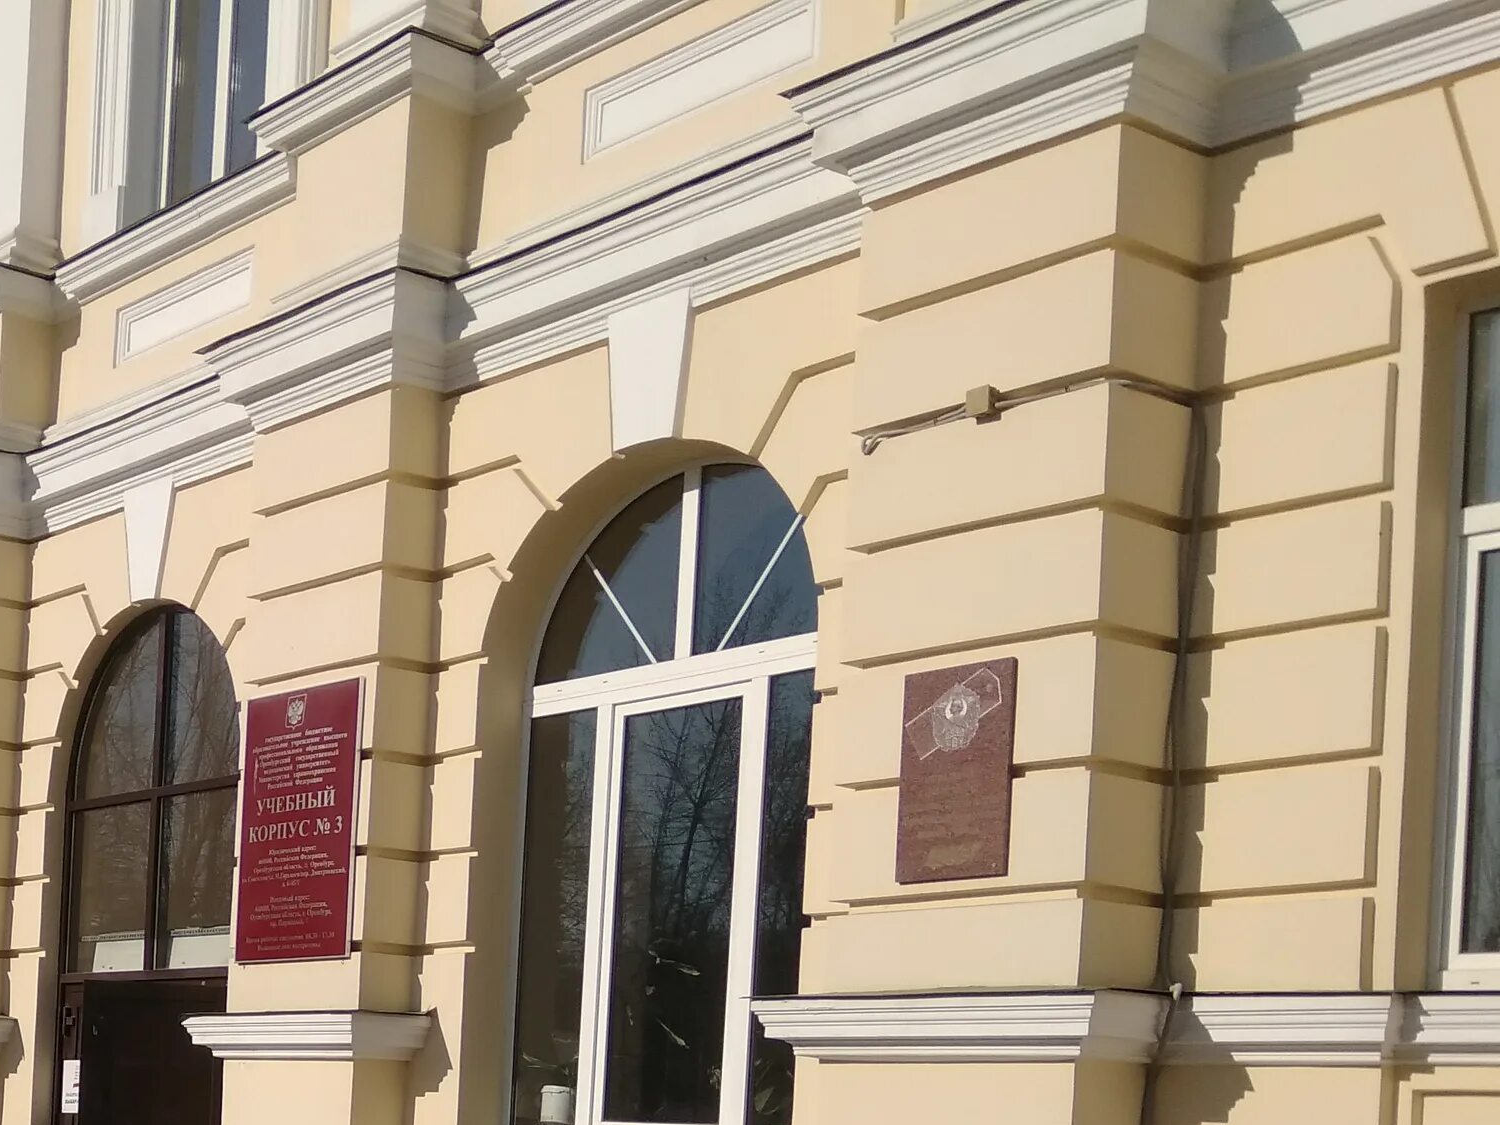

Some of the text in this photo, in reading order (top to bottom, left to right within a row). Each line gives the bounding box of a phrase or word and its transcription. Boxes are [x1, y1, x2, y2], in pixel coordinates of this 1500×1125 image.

[257, 785, 336, 816] УЧЕБНЫЙ
[249, 819, 311, 843] КОРПУС
[334, 815, 343, 833] 3
